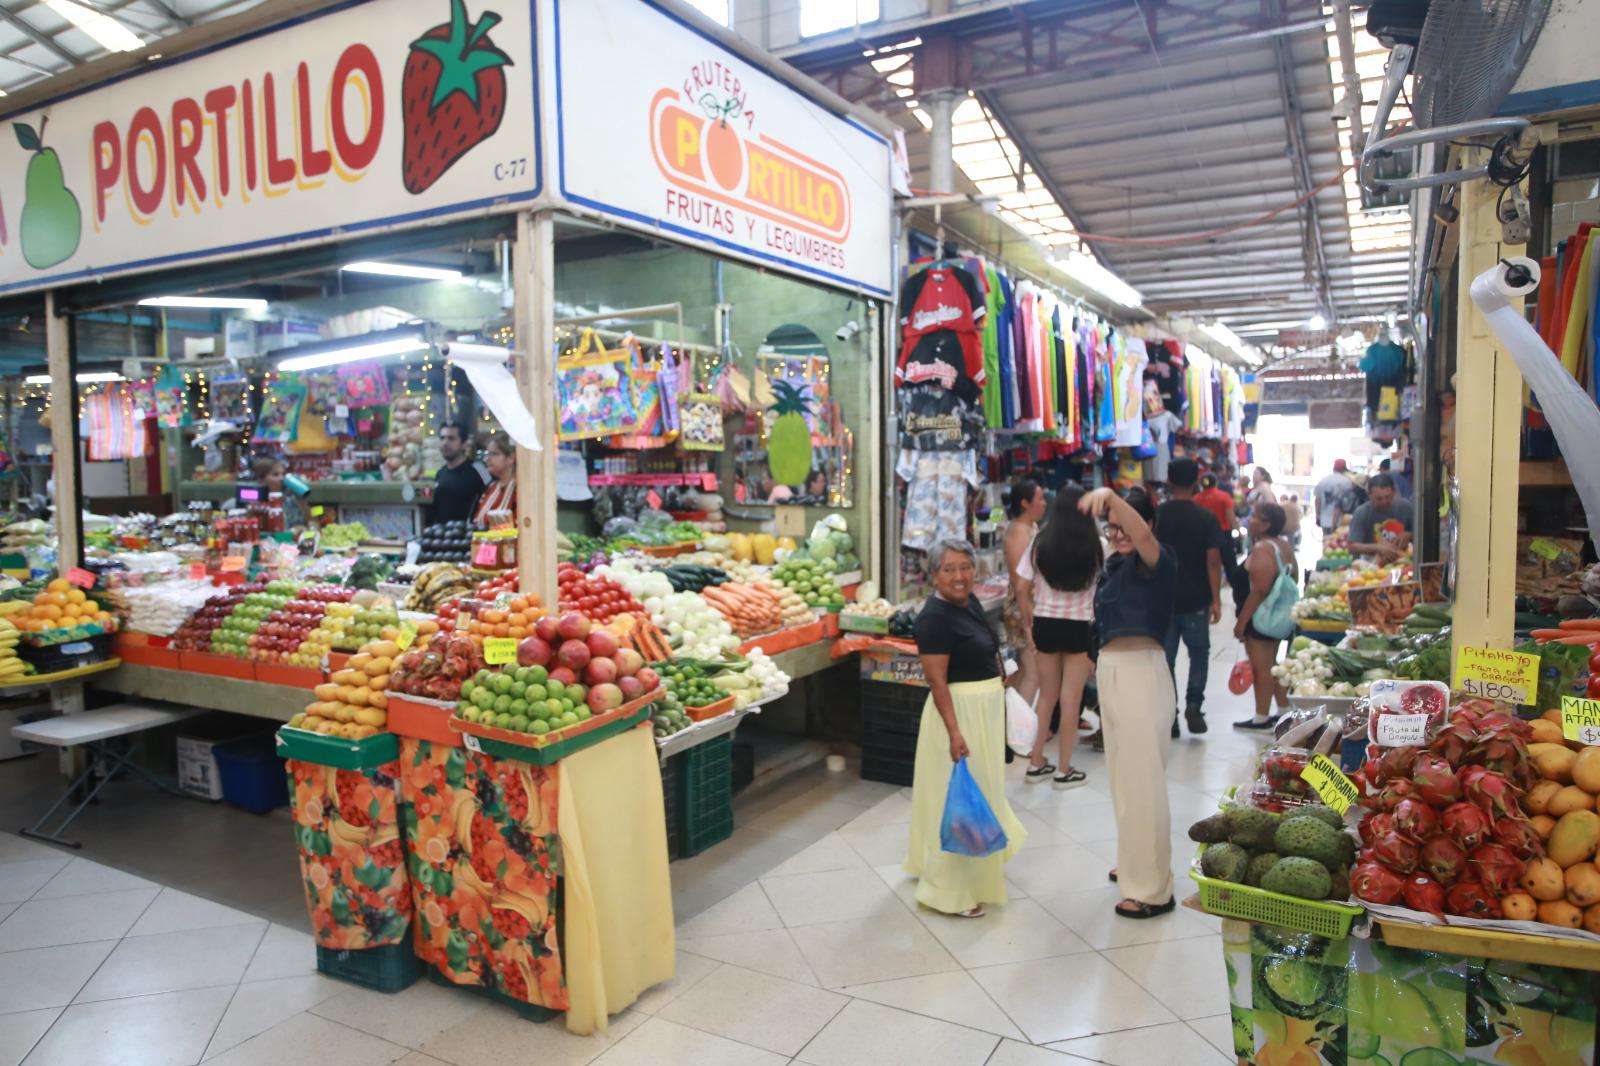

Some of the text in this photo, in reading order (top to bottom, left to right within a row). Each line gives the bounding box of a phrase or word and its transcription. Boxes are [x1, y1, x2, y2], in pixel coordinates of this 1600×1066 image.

[93, 43, 385, 231] PORTILLO
[494, 158, 527, 181] C-77
[676, 117, 838, 227] PORTILLO
[666, 189, 846, 269] FRUTAS Y LEGUMBRES
